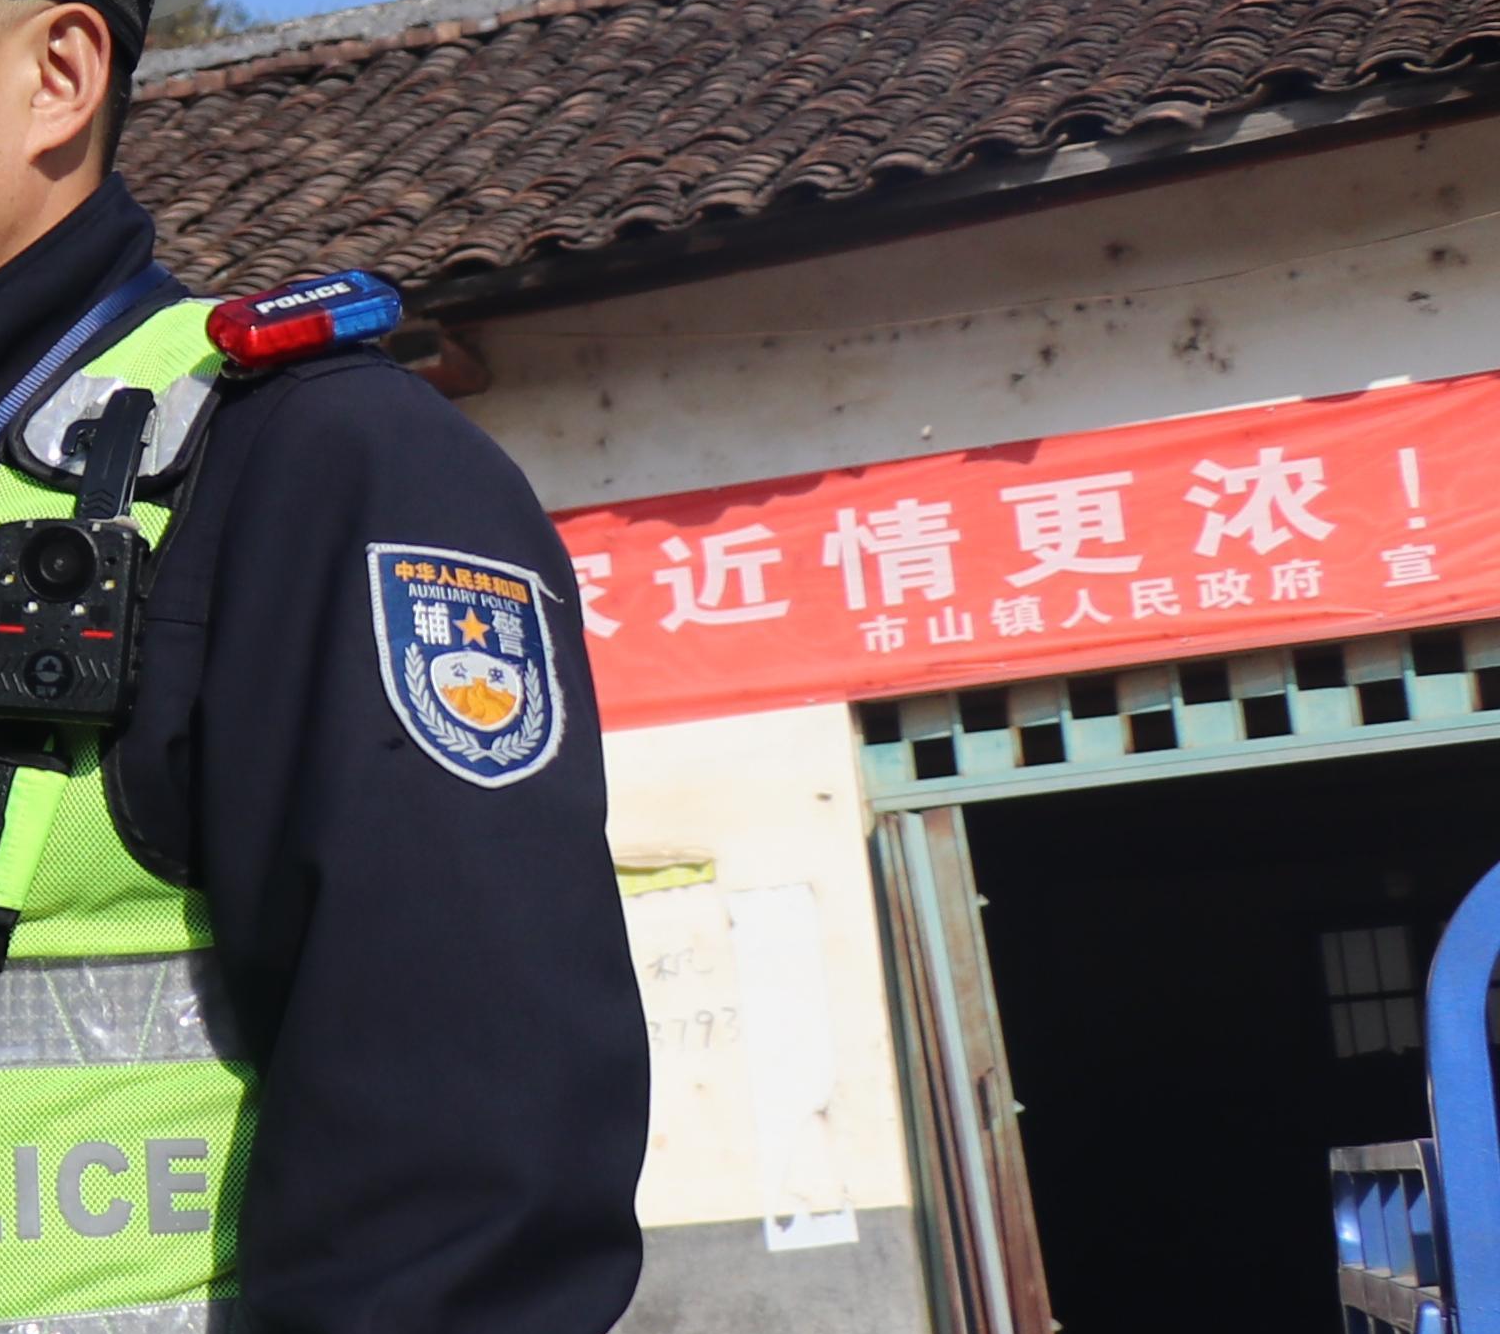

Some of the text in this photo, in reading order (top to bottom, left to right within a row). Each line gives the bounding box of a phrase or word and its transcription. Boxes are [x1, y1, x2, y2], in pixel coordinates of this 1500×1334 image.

[255, 281, 352, 315] POLICE
[395, 560, 529, 604] 中华人民共和国
[408, 582, 522, 615] AUXILIARY POLICE
[858, 543, 1442, 654] 市山镇人民政府 宣
